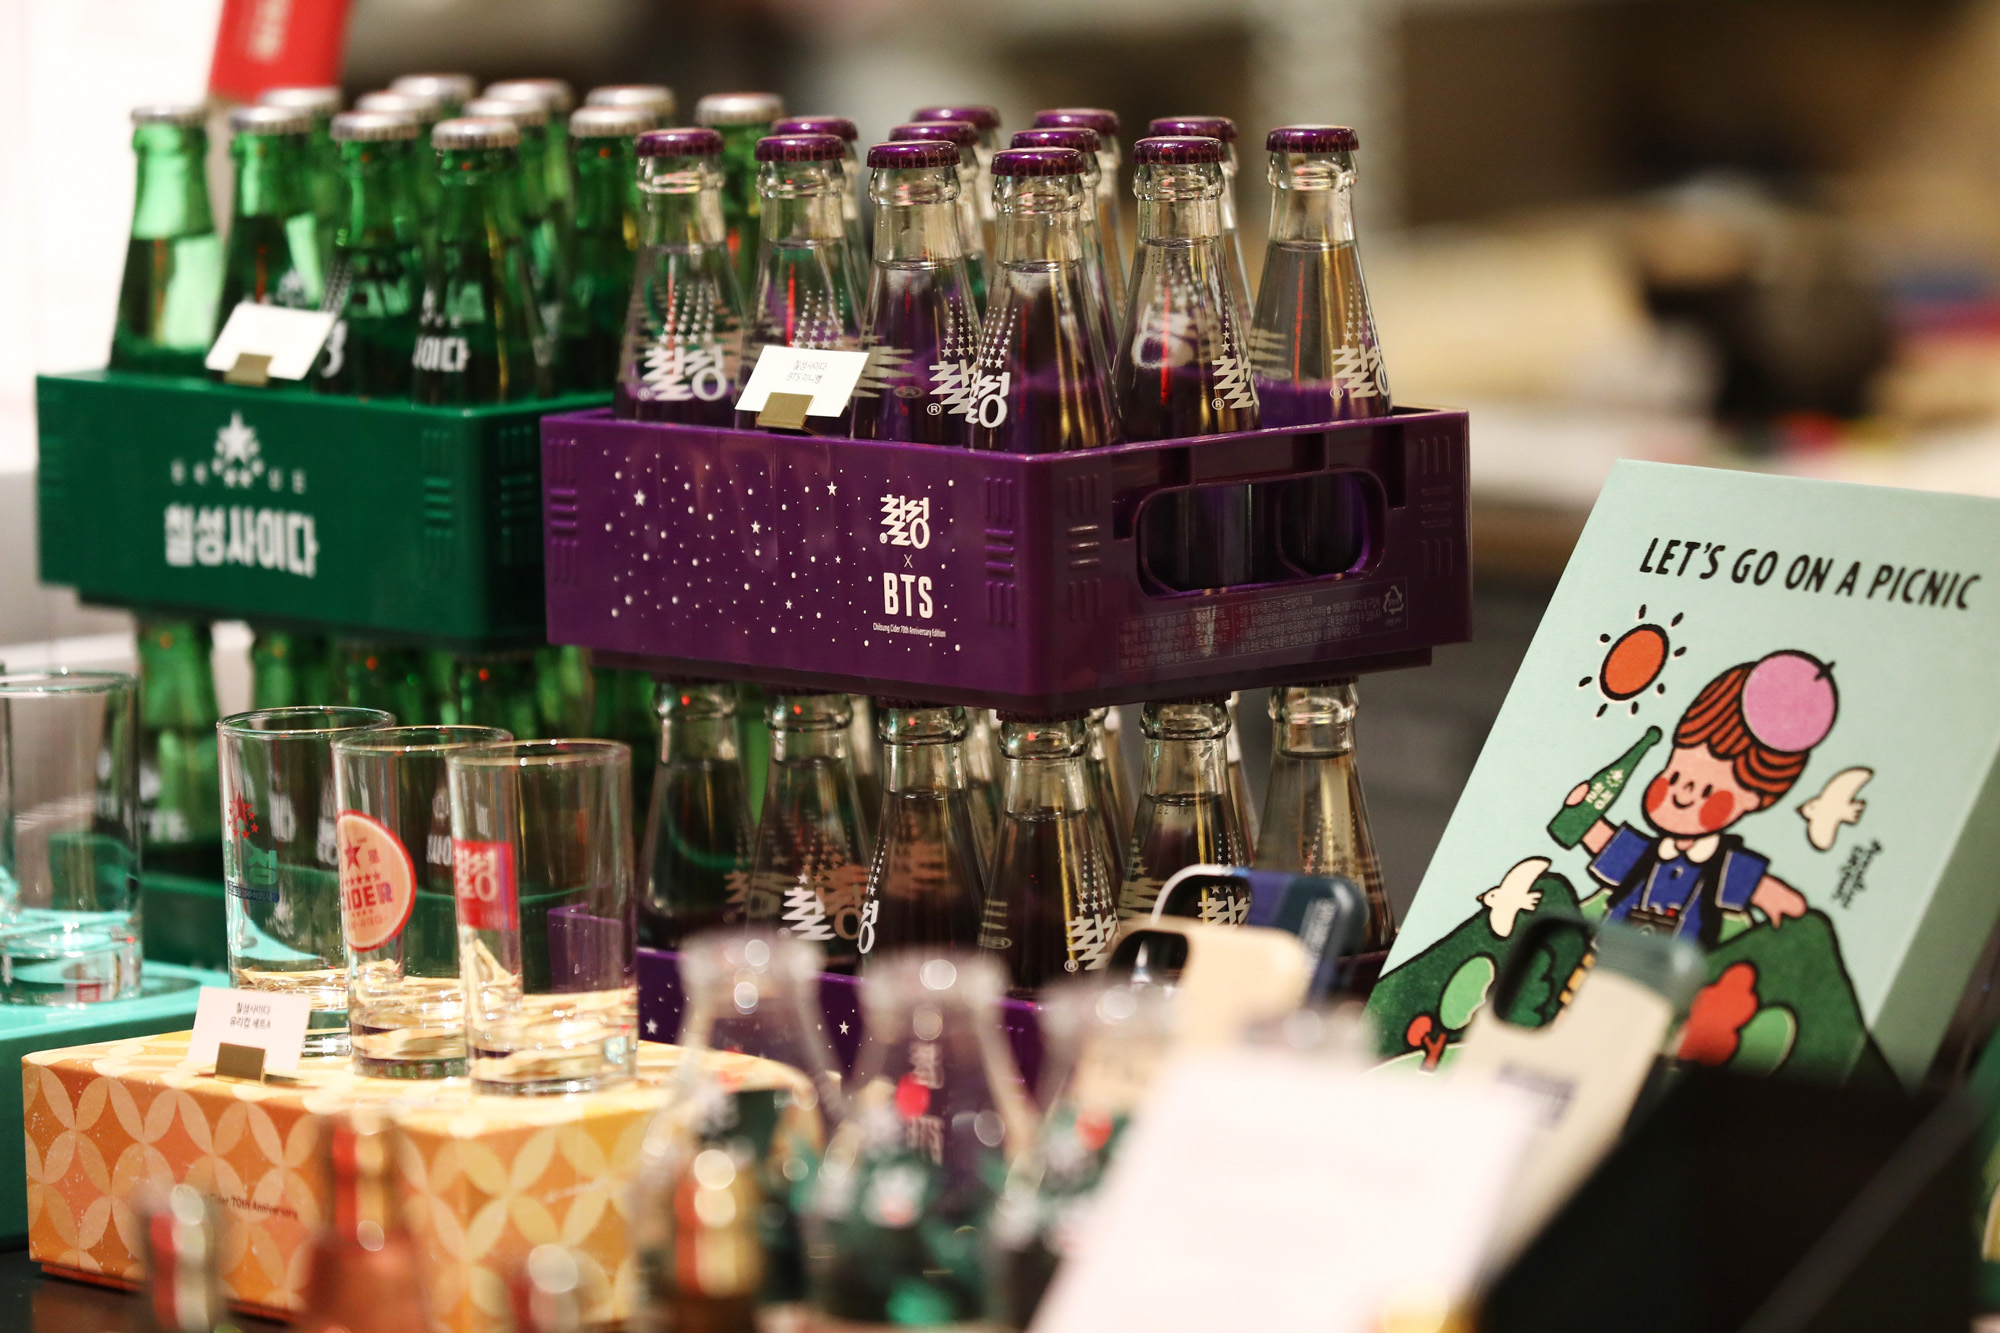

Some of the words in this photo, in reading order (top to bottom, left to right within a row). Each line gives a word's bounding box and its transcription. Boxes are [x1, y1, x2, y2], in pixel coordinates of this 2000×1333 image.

[164, 502, 320, 578] 칠성사이다
[883, 572, 933, 619] BTS
[1640, 537, 1726, 580] LET'S
[1731, 548, 1778, 586] GO
[1785, 554, 1834, 593] ON
[1835, 561, 1861, 597] A
[1867, 564, 1981, 610] PICNIC
[872, 622, 890, 634] Chilsung
[890, 623, 900, 633] Cider
[900, 625, 909, 634] 70th
[909, 626, 932, 638] Anniversary
[931, 628, 946, 638] Edition
